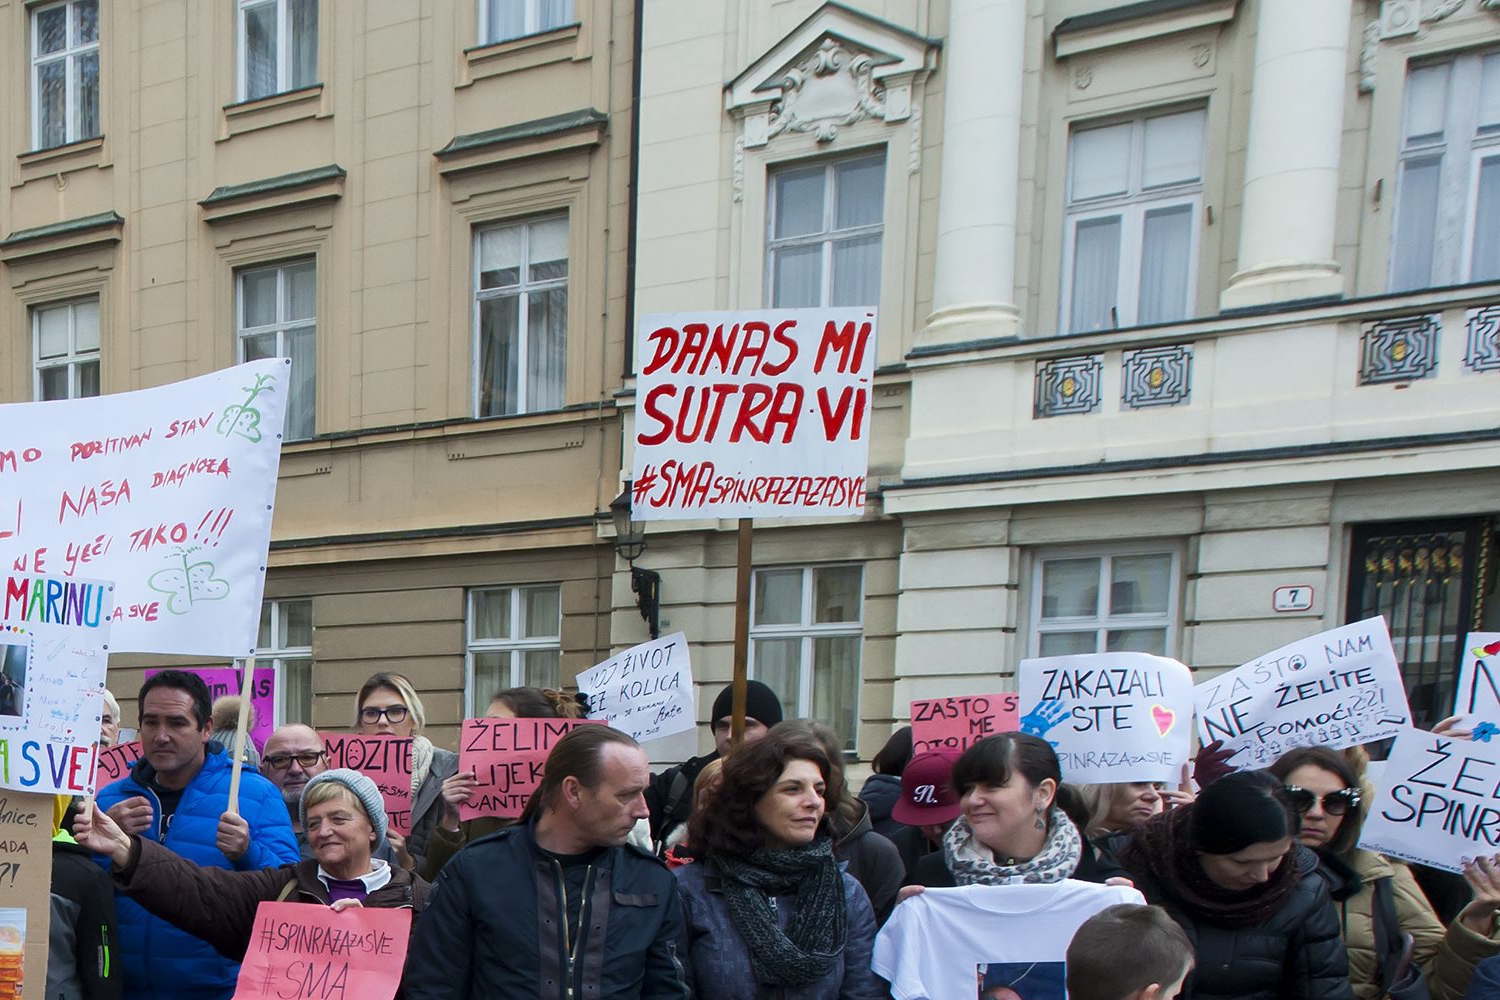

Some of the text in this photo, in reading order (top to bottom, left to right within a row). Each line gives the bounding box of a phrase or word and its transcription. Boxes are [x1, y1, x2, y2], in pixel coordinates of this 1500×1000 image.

[642, 312, 875, 376] DANAS MI
[637, 378, 868, 446] SUTRA VI
[70, 427, 152, 463] POZITIVAN
[165, 411, 214, 440] STAV
[58, 478, 132, 525] NAŠA
[151, 457, 234, 490] DIAGNOZA
[4, 576, 104, 628] MARINU
[128, 601, 160, 622] SVE
[1289, 589, 1300, 603] 7
[621, 643, 676, 679] ŽIVOT
[1324, 634, 1373, 664] NAM
[620, 672, 680, 702] KOLICA
[1042, 669, 1164, 700] ZAKAZALI
[914, 698, 989, 721] ZAŠTO
[970, 715, 996, 734] ME
[1072, 705, 1133, 732] STE
[1203, 696, 1265, 742] NE
[472, 762, 544, 793] LIJEK
